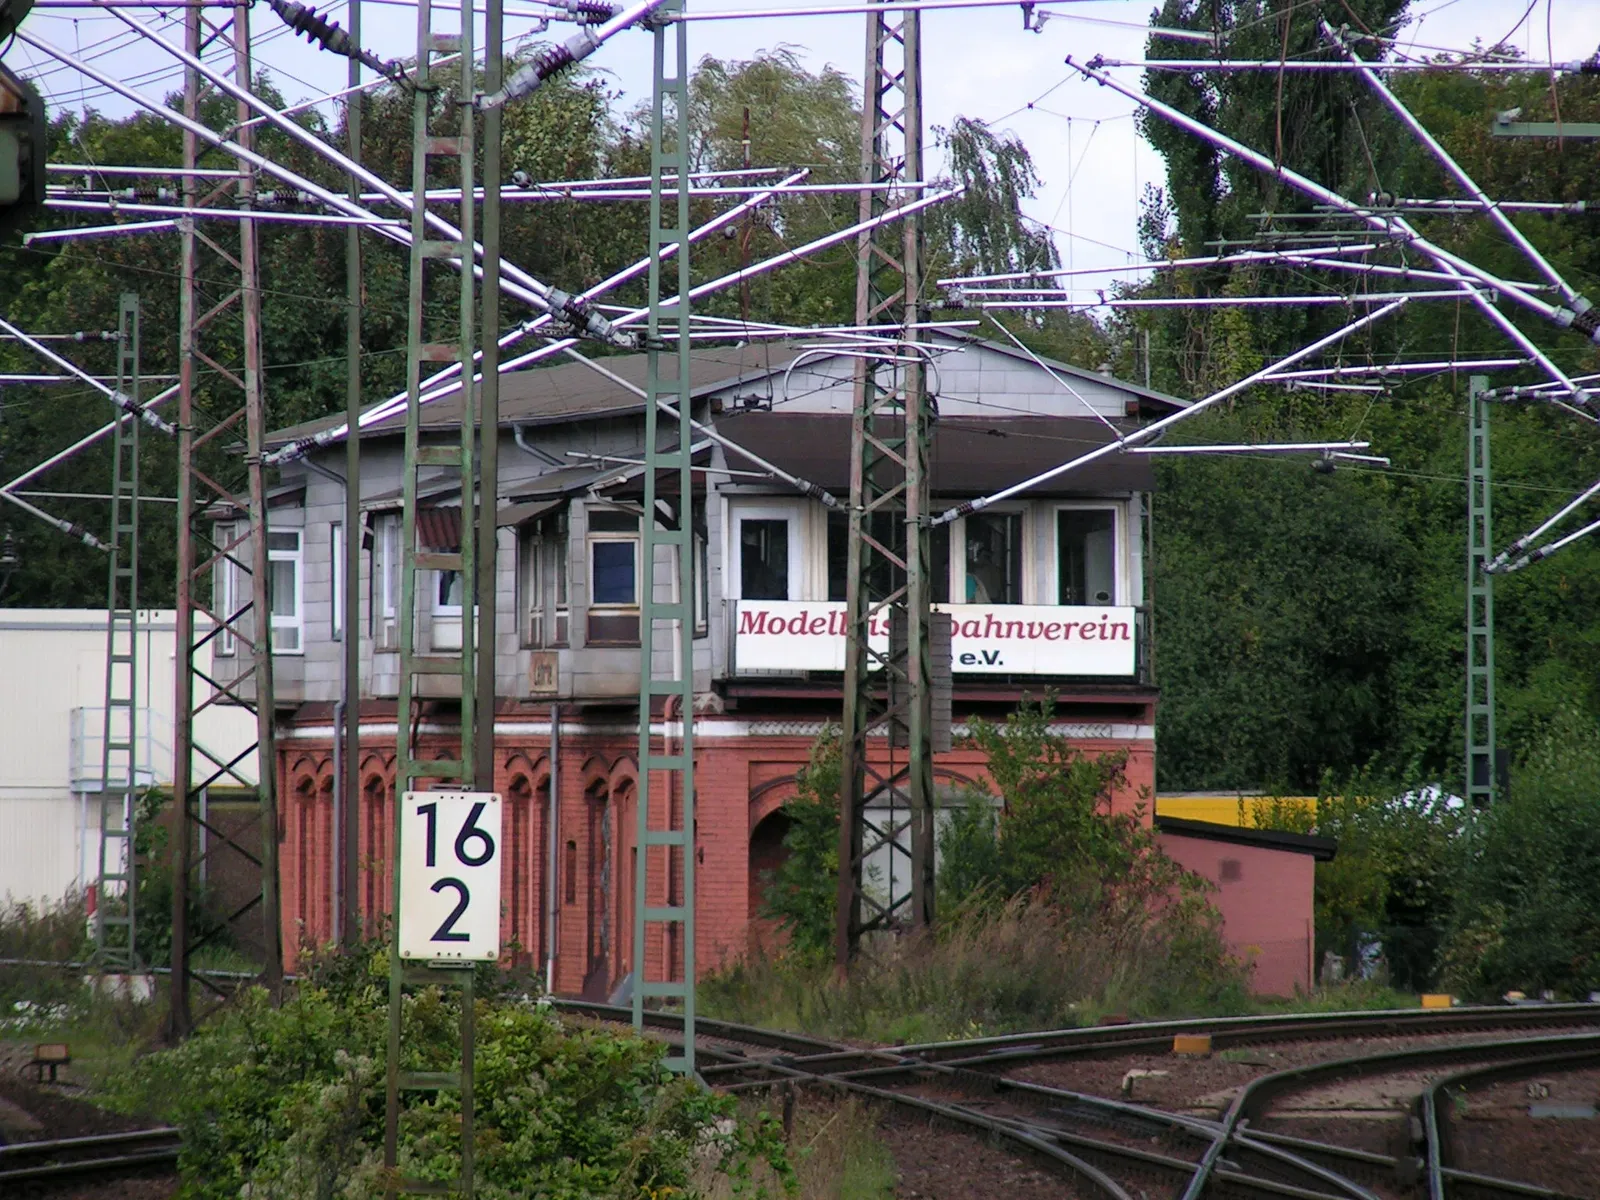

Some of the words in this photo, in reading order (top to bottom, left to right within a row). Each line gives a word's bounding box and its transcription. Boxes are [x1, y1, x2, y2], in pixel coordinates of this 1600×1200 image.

[959, 649, 1004, 666] e.V.
[416, 801, 496, 867] 16
[429, 876, 471, 942] 2
